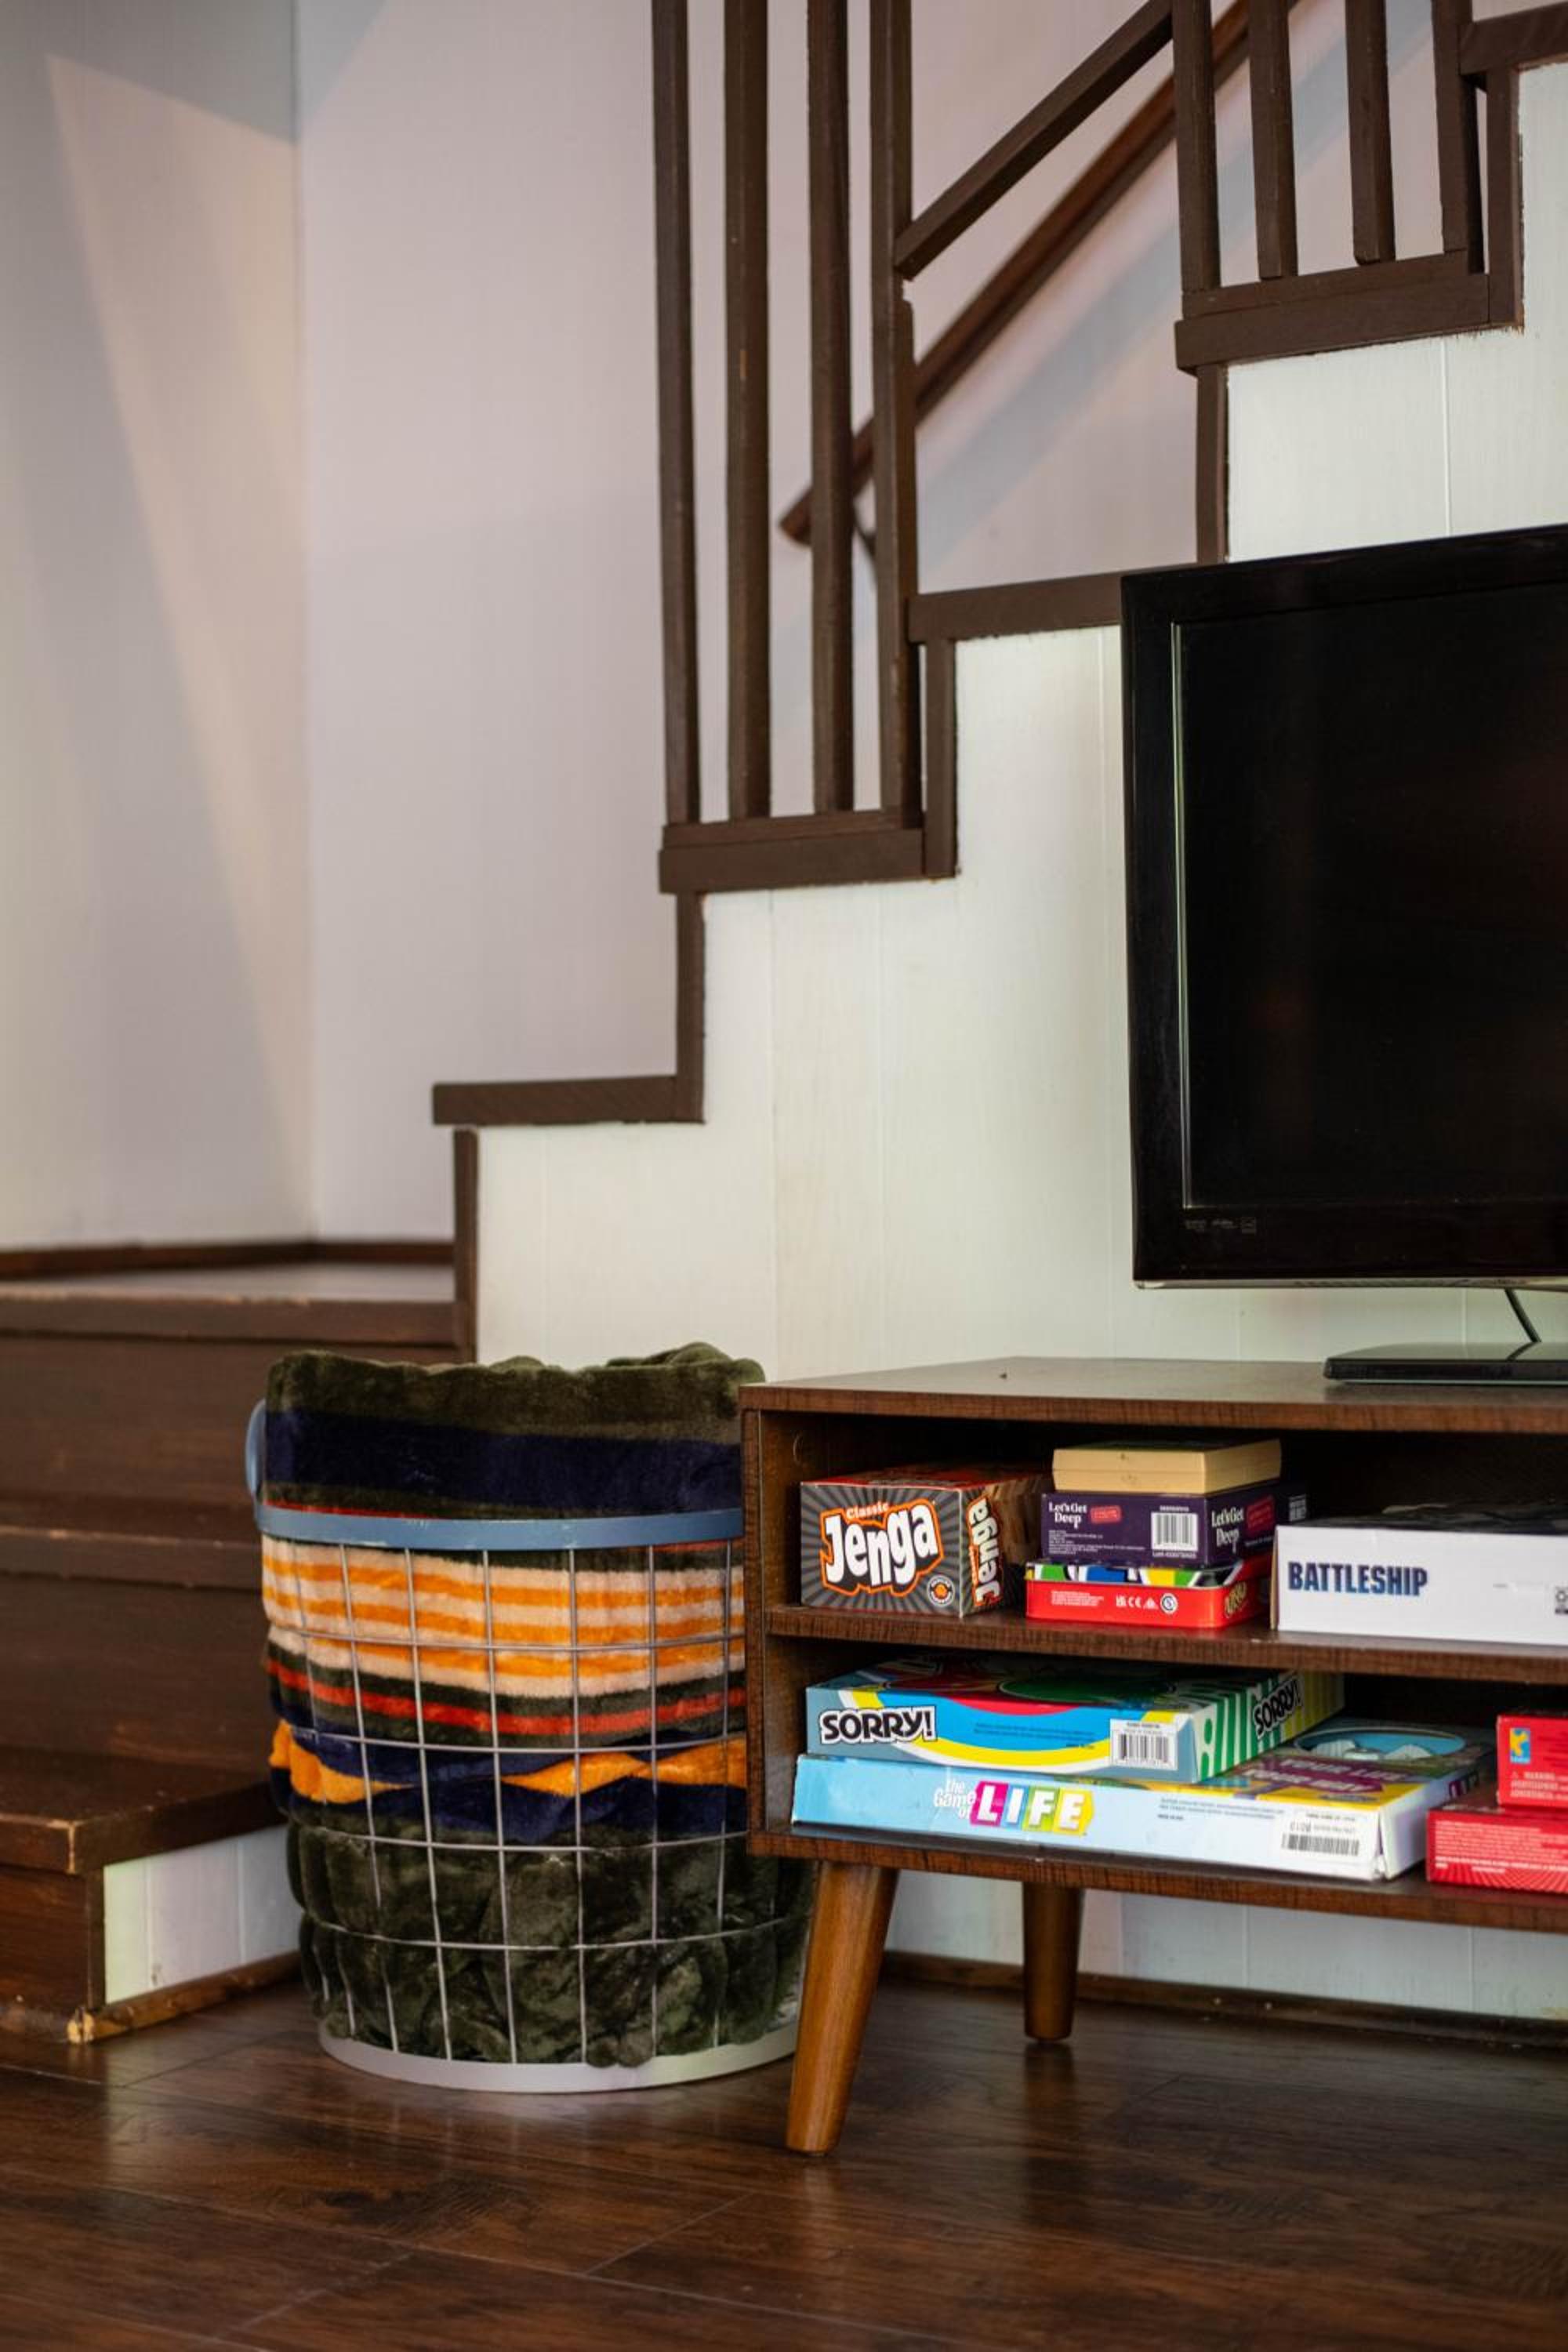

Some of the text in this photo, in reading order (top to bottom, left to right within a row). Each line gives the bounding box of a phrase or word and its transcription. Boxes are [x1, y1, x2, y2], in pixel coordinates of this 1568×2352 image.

[846, 1501, 889, 1519] Classic
[1054, 1512, 1082, 1530] Deep
[1071, 1503, 1087, 1513] Get
[825, 1504, 938, 1586] Jenga
[968, 1498, 1001, 1602] Jenga
[1216, 1527, 1240, 1554] Deep
[1287, 1561, 1428, 1596] BATTLESHIP
[1254, 1679, 1301, 1737] SORRY!
[822, 1710, 932, 1740] SORRY!
[977, 1784, 1085, 1830] LIFE
